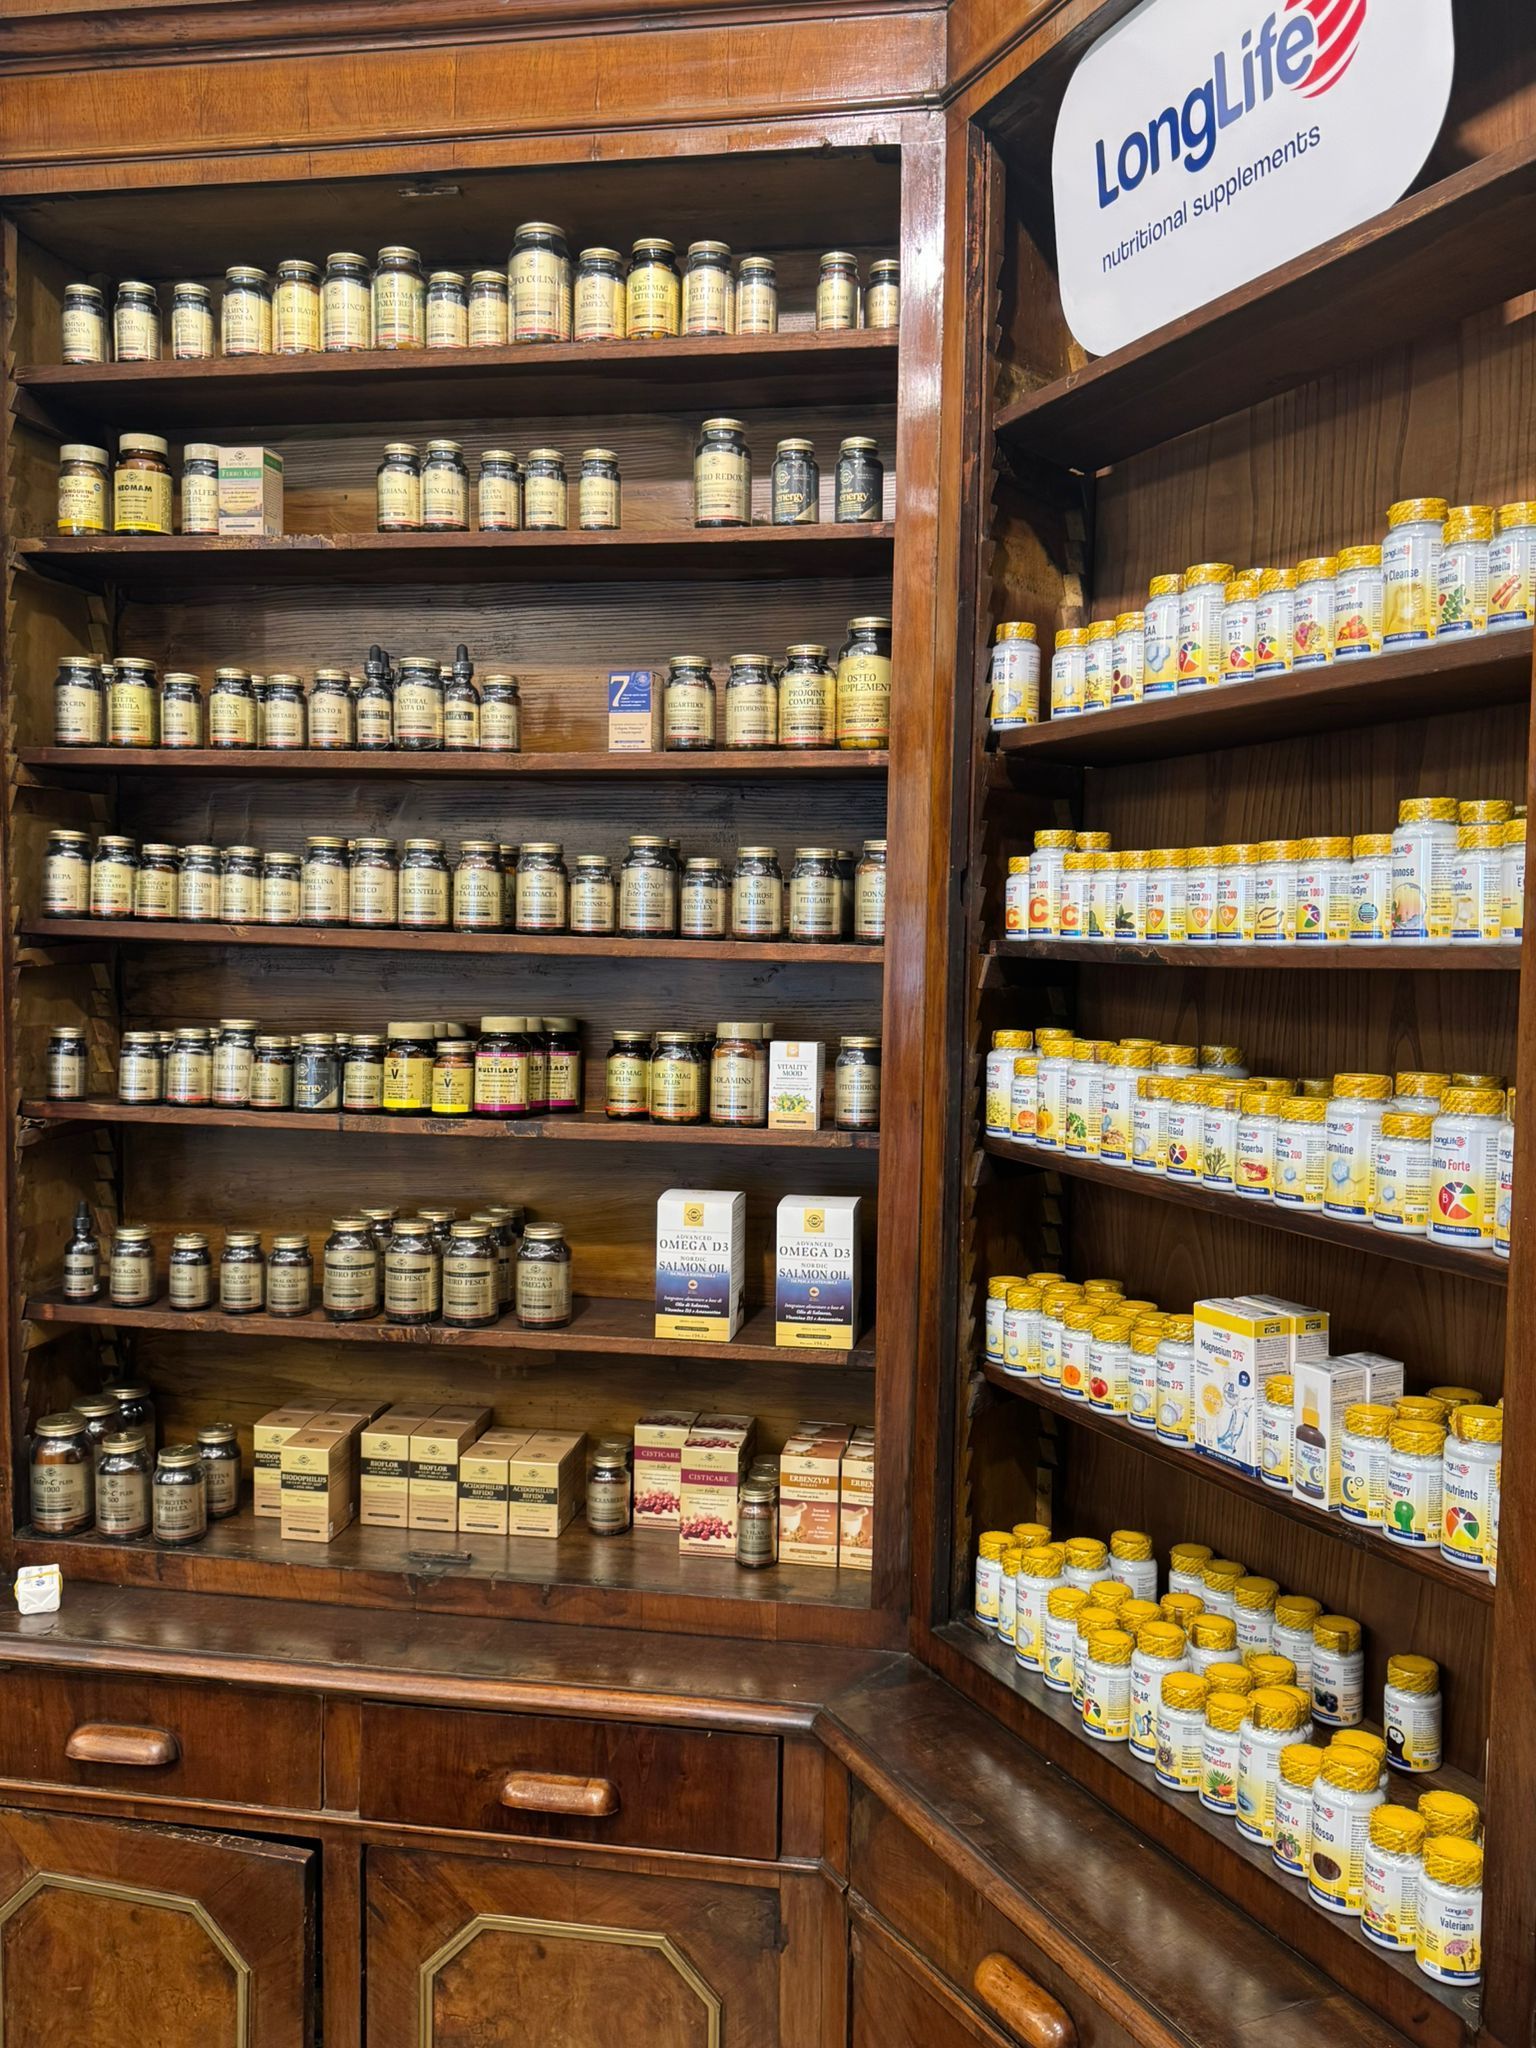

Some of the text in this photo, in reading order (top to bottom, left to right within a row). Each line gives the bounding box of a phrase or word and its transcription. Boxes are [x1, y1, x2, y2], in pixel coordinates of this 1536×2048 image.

[1095, 11, 1315, 210] LongLife
[1101, 124, 1322, 273] nutritional supplements
[715, 473, 743, 482] REDOX
[117, 484, 153, 493] NEOMAM
[776, 492, 806, 502] energy
[839, 492, 869, 502] energy
[1388, 568, 1419, 581] Cleanse
[847, 673, 876, 682] OSTEO
[610, 675, 630, 708] 7
[788, 689, 826, 697] PROJOINT
[788, 698, 826, 706] COMPLEX
[777, 1063, 808, 1071] VITALITY
[1240, 1140, 1264, 1153] Superba
[1447, 1157, 1471, 1172] Forte
[1442, 1193, 1449, 1204] B
[659, 1239, 729, 1252] OMEGA D3
[779, 1246, 851, 1258] OMEGA D3
[659, 1260, 728, 1274] SALMON OIL
[404, 1274, 428, 1282] PESCE
[779, 1267, 849, 1280] SALMON OIL
[1200, 1339, 1245, 1363] Magnesium 375
[1170, 1379, 1185, 1391] 375
[641, 1450, 680, 1459] CISTICARE
[370, 1460, 399, 1468] BIOFLOR
[419, 1464, 448, 1472] BIOFLOR
[281, 1473, 327, 1483] BIODOPHILUS
[688, 1473, 729, 1483] CISTICARE
[789, 1474, 830, 1484] ERBENZYM
[462, 1482, 505, 1491] ACIDOPHILUS
[513, 1486, 555, 1494] ACIDOPHILUS
[1387, 1479, 1411, 1496] Memory
[472, 1489, 494, 1497] BIFIDO
[1314, 1824, 1336, 1843] Rosso
[1439, 1915, 1475, 1932] Valeriana
